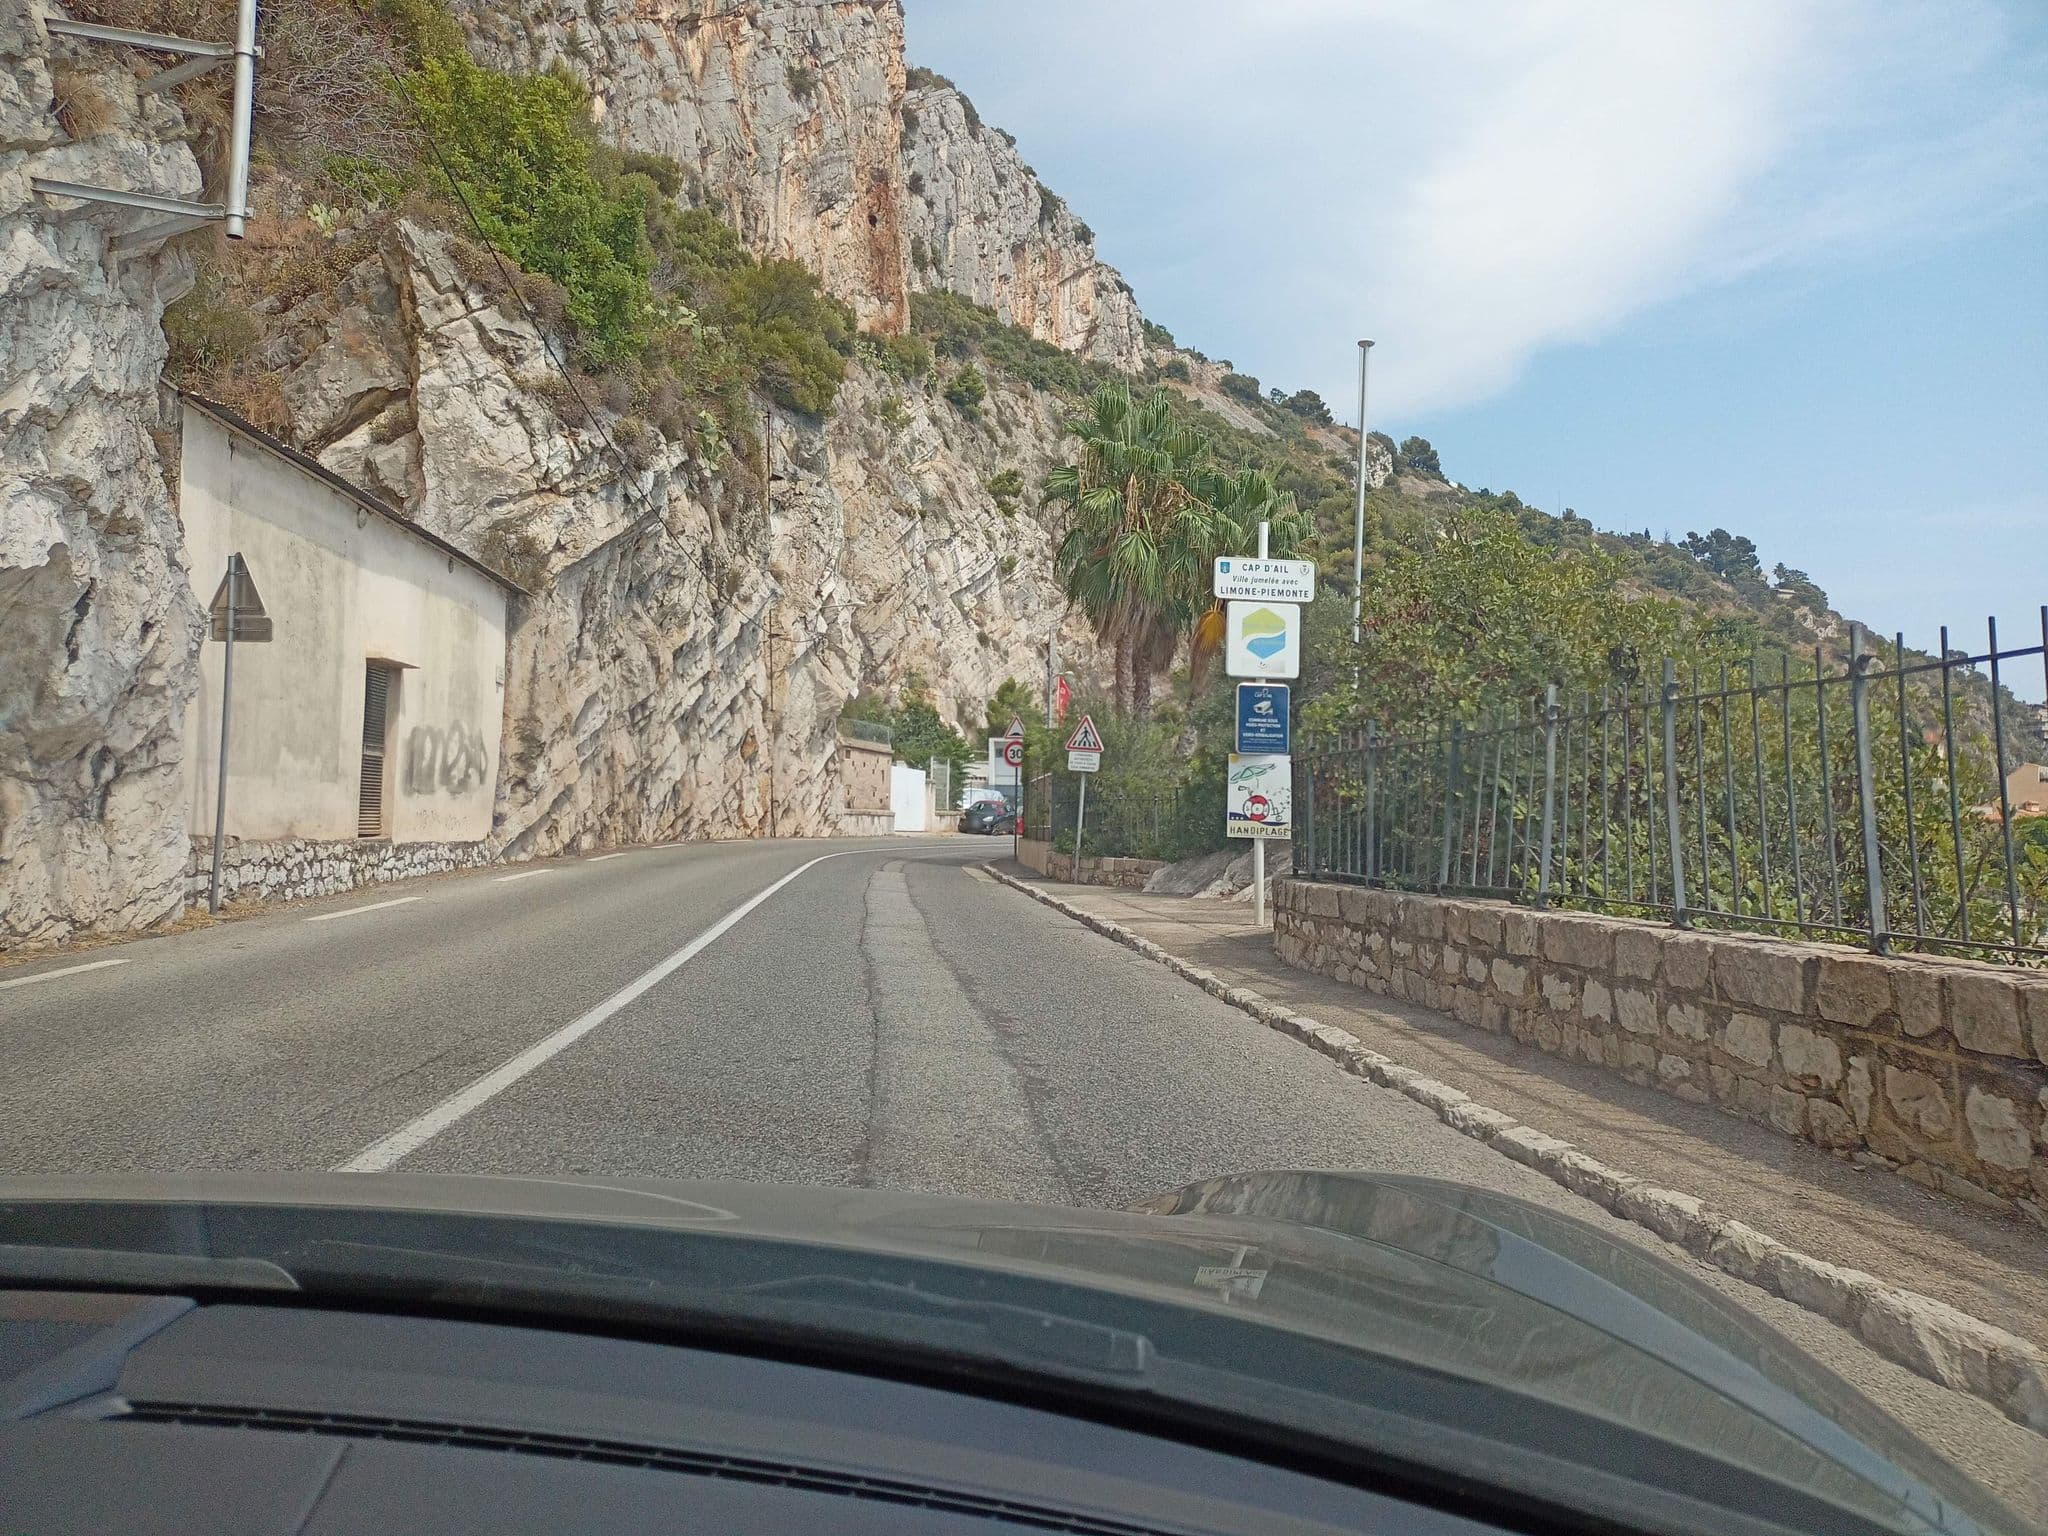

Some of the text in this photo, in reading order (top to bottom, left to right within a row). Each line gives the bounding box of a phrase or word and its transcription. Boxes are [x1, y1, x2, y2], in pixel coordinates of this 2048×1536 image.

[1242, 563, 1289, 574] CAP D'AIL
[1232, 575, 1249, 583] Ville
[1220, 586, 1309, 598] LIMONE-PIEMONTE
[1009, 749, 1024, 759] 30
[1230, 826, 1289, 836] HANDIPLAGE
